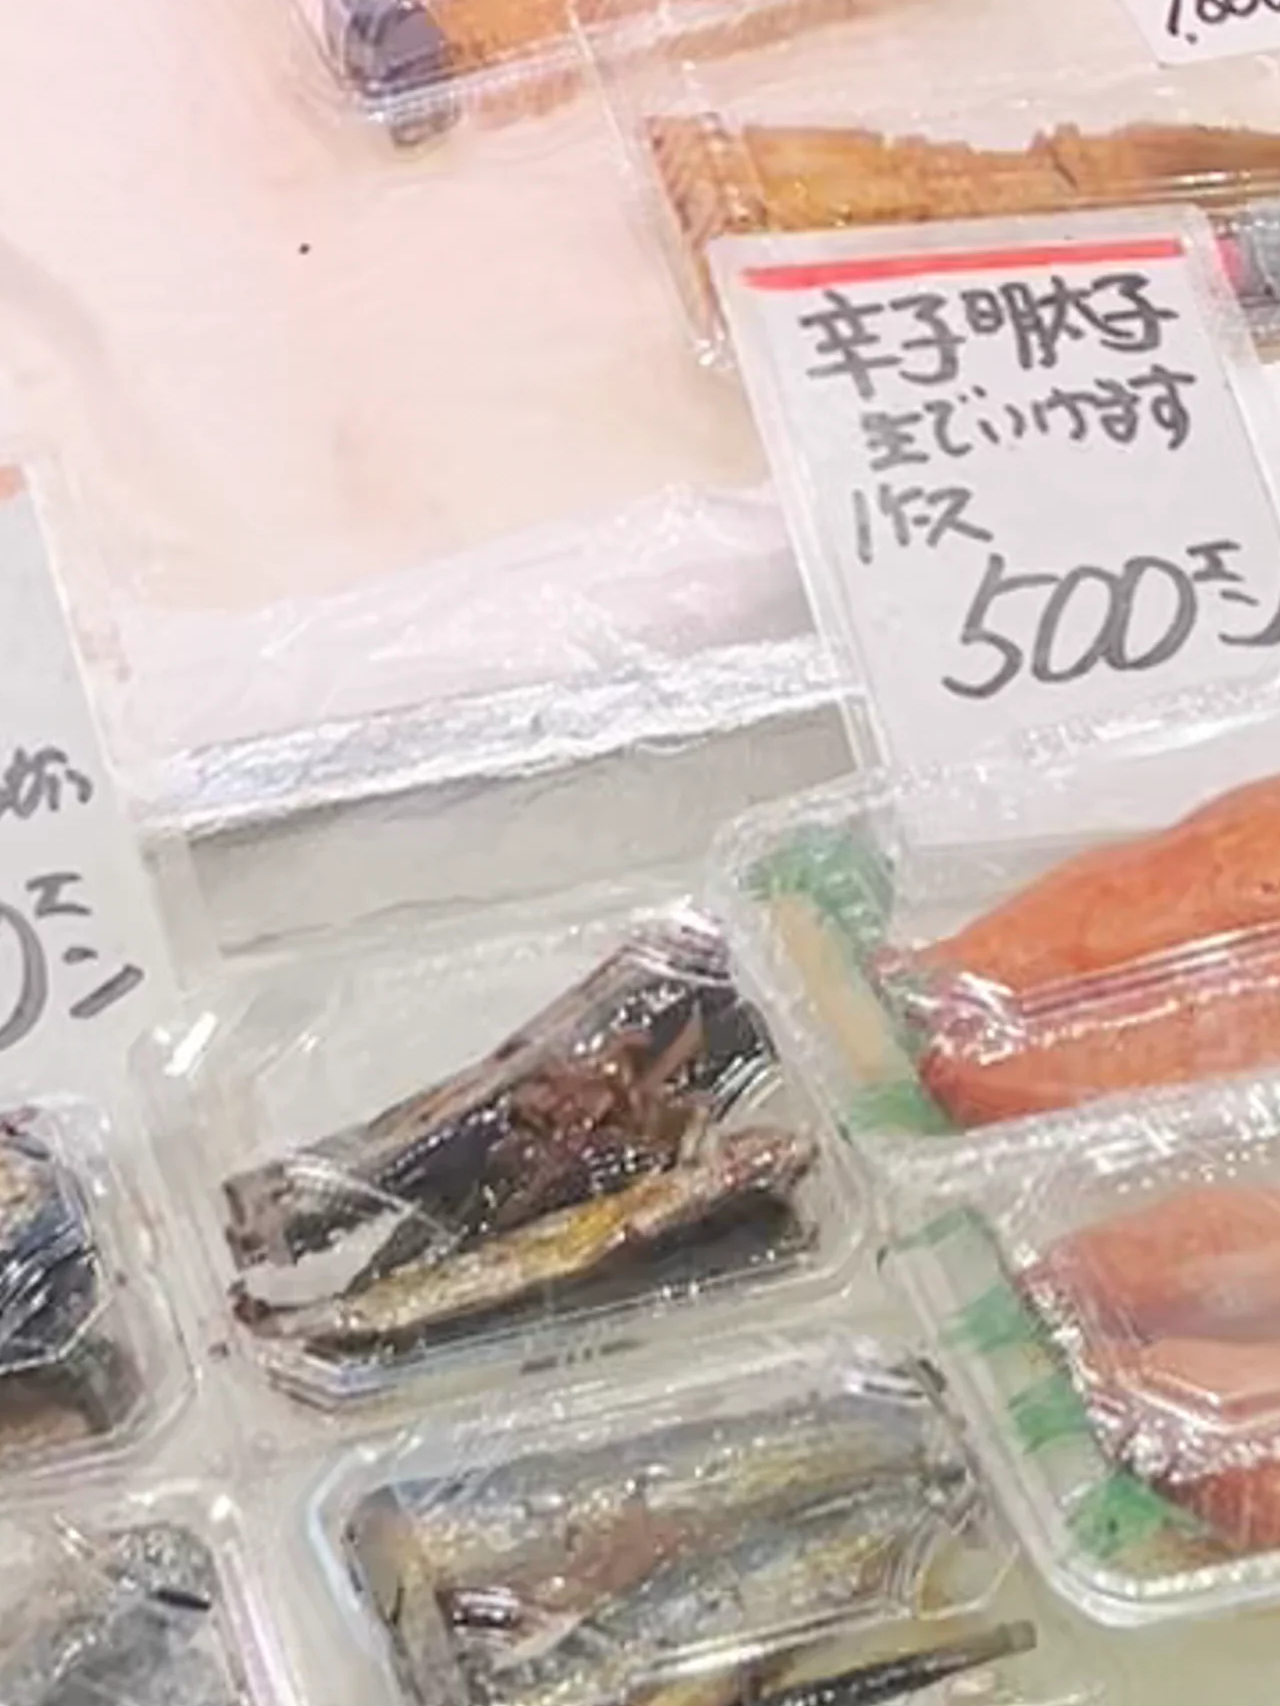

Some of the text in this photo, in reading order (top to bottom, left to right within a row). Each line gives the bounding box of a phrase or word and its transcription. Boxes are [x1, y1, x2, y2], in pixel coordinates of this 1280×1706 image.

[798, 273, 1178, 398] 辛子明太子
[863, 364, 1196, 473] 生でいけます
